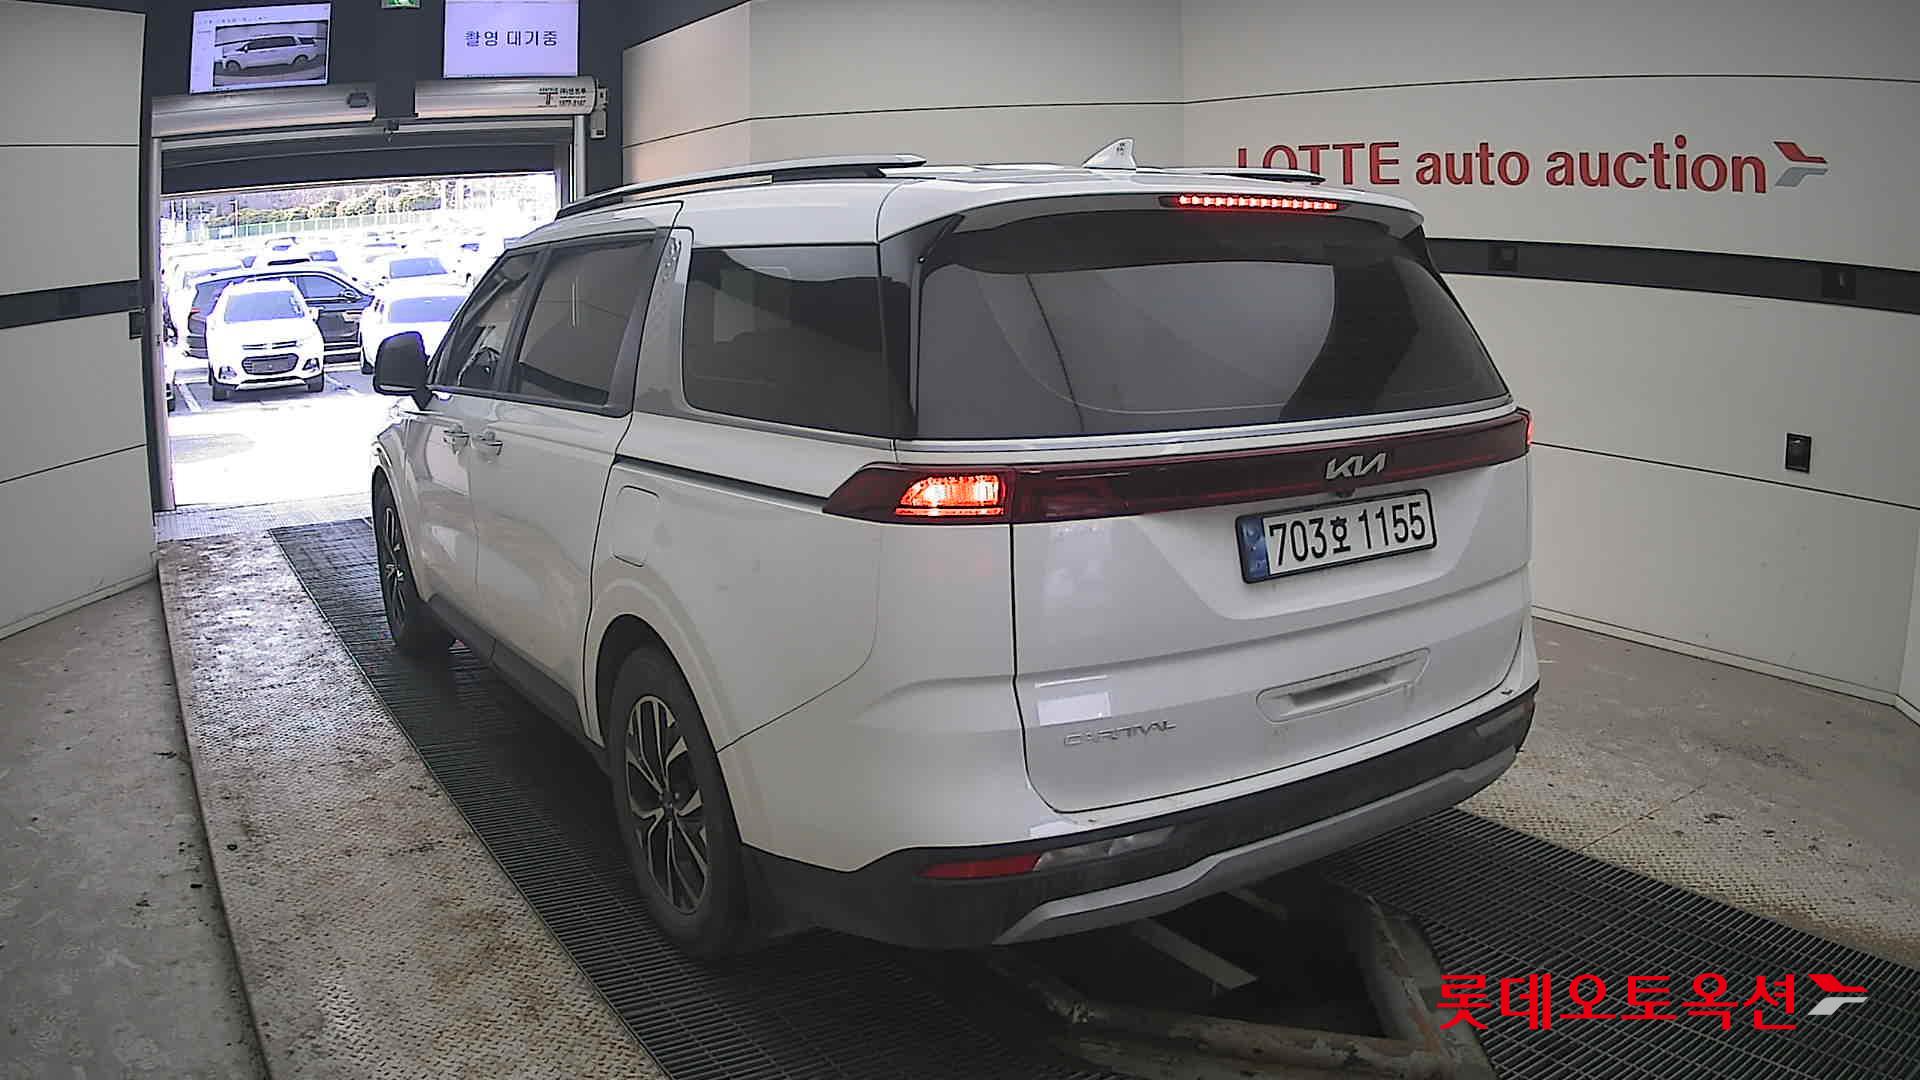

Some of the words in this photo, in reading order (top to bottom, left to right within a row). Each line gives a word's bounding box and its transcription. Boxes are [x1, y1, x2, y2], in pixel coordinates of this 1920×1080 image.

[464, 31, 498, 47] 촬영
[507, 31, 558, 47] 대기중
[1416, 142, 1530, 186] auto
[1546, 134, 1767, 193] auction
[1325, 452, 1387, 480] KIA
[1269, 516, 1351, 566] 703호
[1358, 502, 1426, 550] 1155
